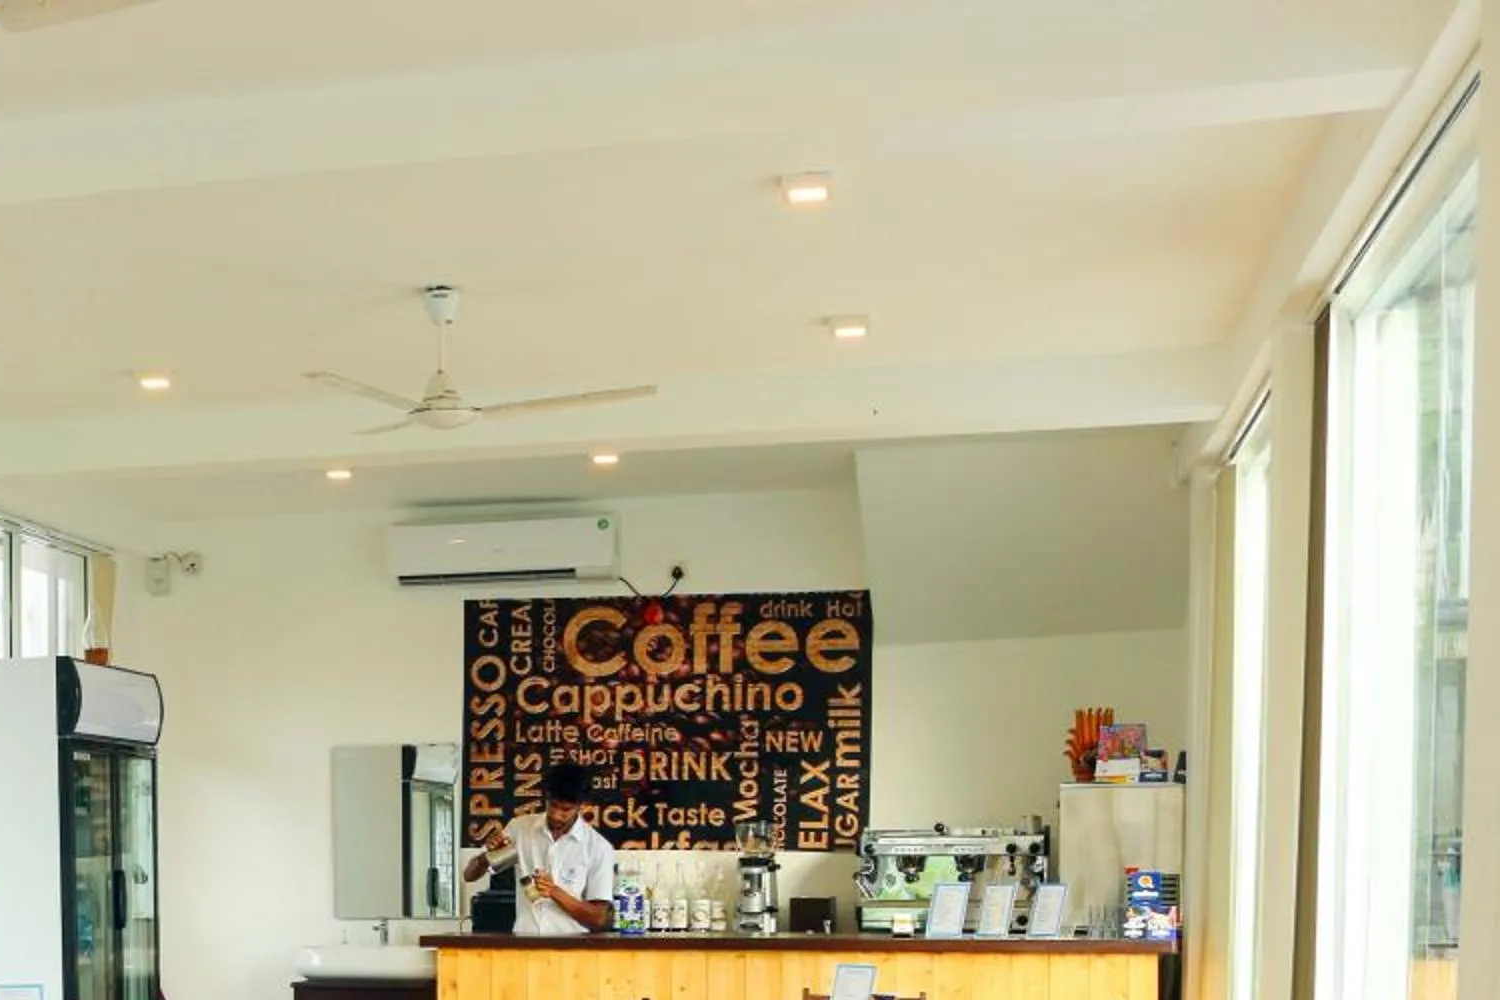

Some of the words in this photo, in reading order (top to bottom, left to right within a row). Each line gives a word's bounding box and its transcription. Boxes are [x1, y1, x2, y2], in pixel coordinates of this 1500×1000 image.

[510, 599, 532, 676] CREA
[542, 600, 556, 673] CHOCOL
[759, 600, 813, 618] drink
[563, 602, 861, 678] Coffee
[516, 674, 805, 722] Cappuchino
[827, 682, 862, 767] milk
[467, 655, 507, 843] SPRESSO
[515, 720, 580, 743] Latte
[587, 723, 678, 744] Caffeine
[765, 730, 824, 753] NEW
[622, 751, 733, 781] DRINK
[732, 718, 760, 823] Mocha
[580, 798, 649, 829] ack
[654, 802, 726, 827] Taste
